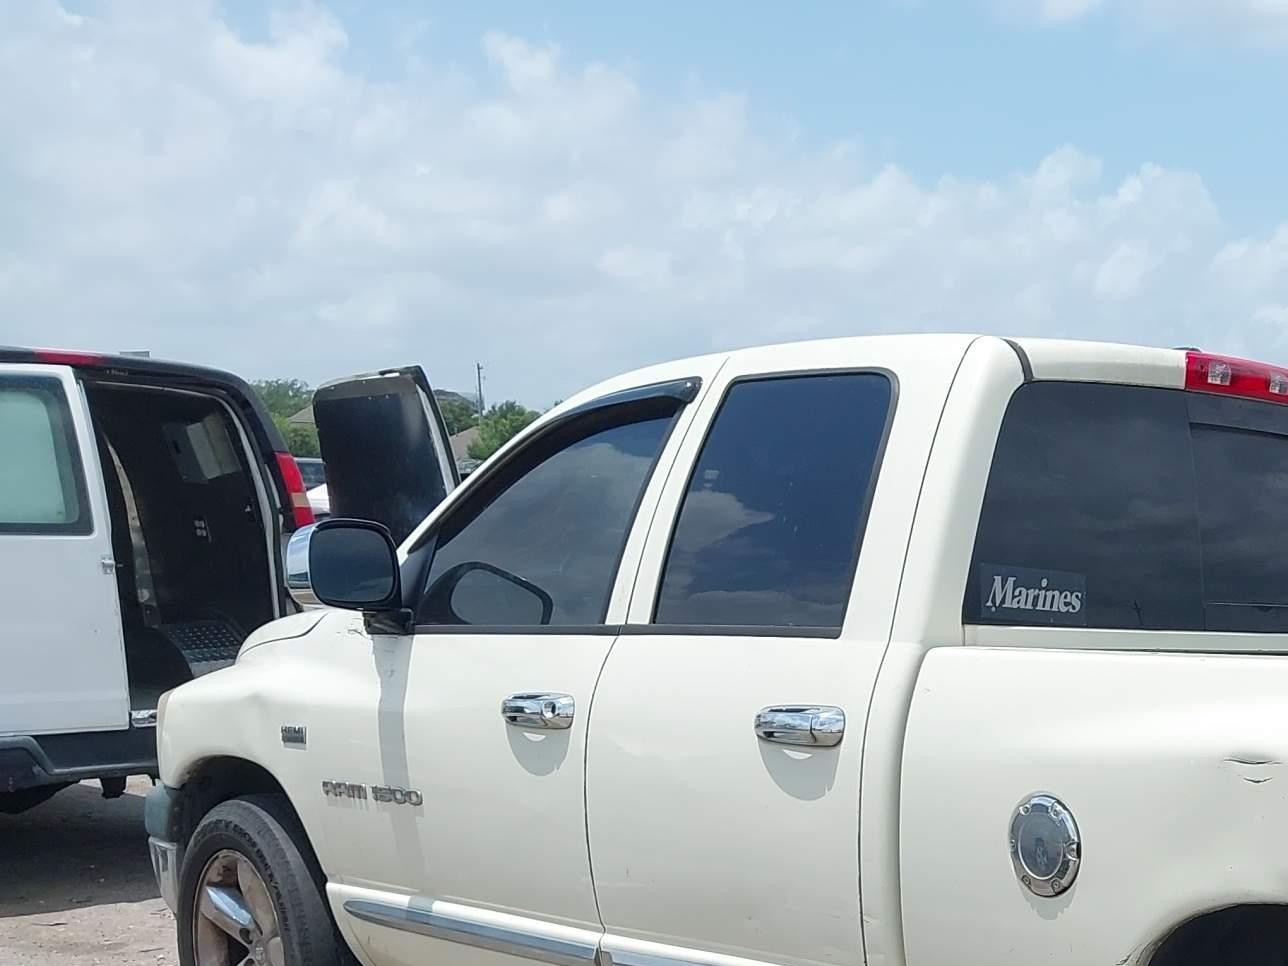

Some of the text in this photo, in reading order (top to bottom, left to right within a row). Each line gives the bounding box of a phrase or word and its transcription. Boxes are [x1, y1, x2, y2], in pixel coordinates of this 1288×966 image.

[985, 575, 1082, 613] Marines
[281, 725, 306, 735] HEMI
[322, 781, 423, 806] RAM 1500
